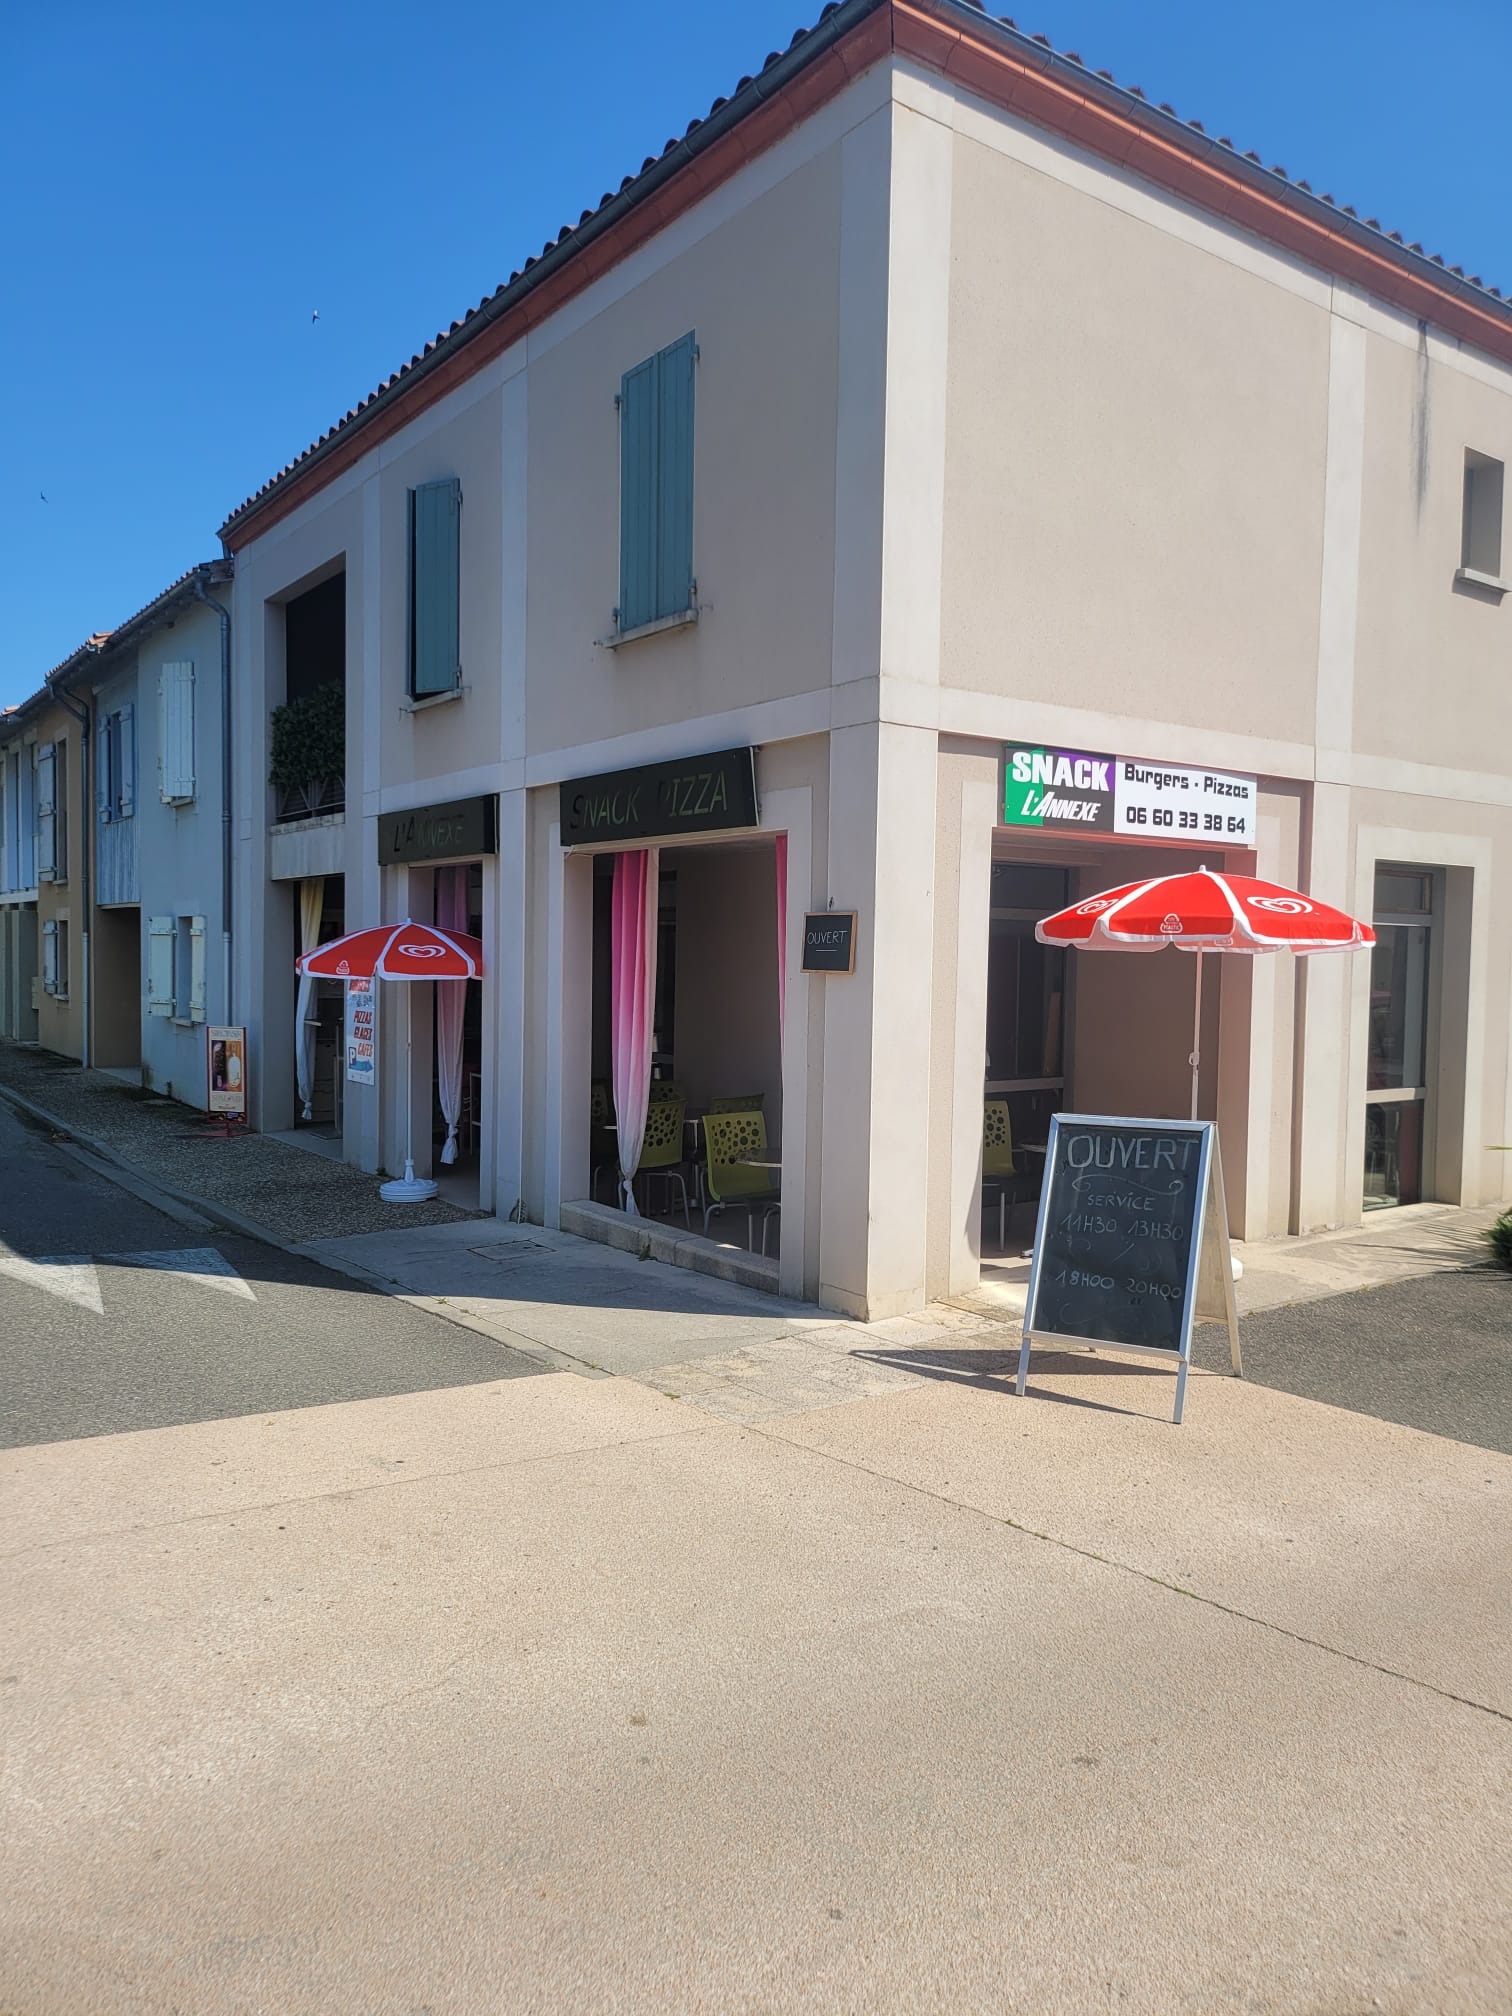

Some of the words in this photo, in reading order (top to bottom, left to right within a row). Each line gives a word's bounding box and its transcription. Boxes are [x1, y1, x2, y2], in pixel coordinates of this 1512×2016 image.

[1012, 751, 1110, 792] SNACK
[1124, 763, 1189, 791] Burgers
[1203, 776, 1249, 800] Pizzas
[570, 786, 641, 829] SNACK
[657, 770, 728, 818] PIZZA
[1020, 789, 1101, 822] L'ANNEXE
[1126, 806, 1147, 825] 06
[1152, 809, 1173, 827] 60
[1178, 811, 1198, 829] 33
[1203, 813, 1222, 832] 38
[1227, 816, 1246, 834] 64
[807, 930, 848, 945] OUVERT
[1067, 1135, 1200, 1171] OUVERT
[1087, 1192, 1155, 1211] SERVICE
[1060, 1211, 1118, 1234] 11H30
[1127, 1219, 1184, 1241] 13H30
[1055, 1269, 1115, 1290] 18H00
[1126, 1277, 1182, 1300] 20H00
